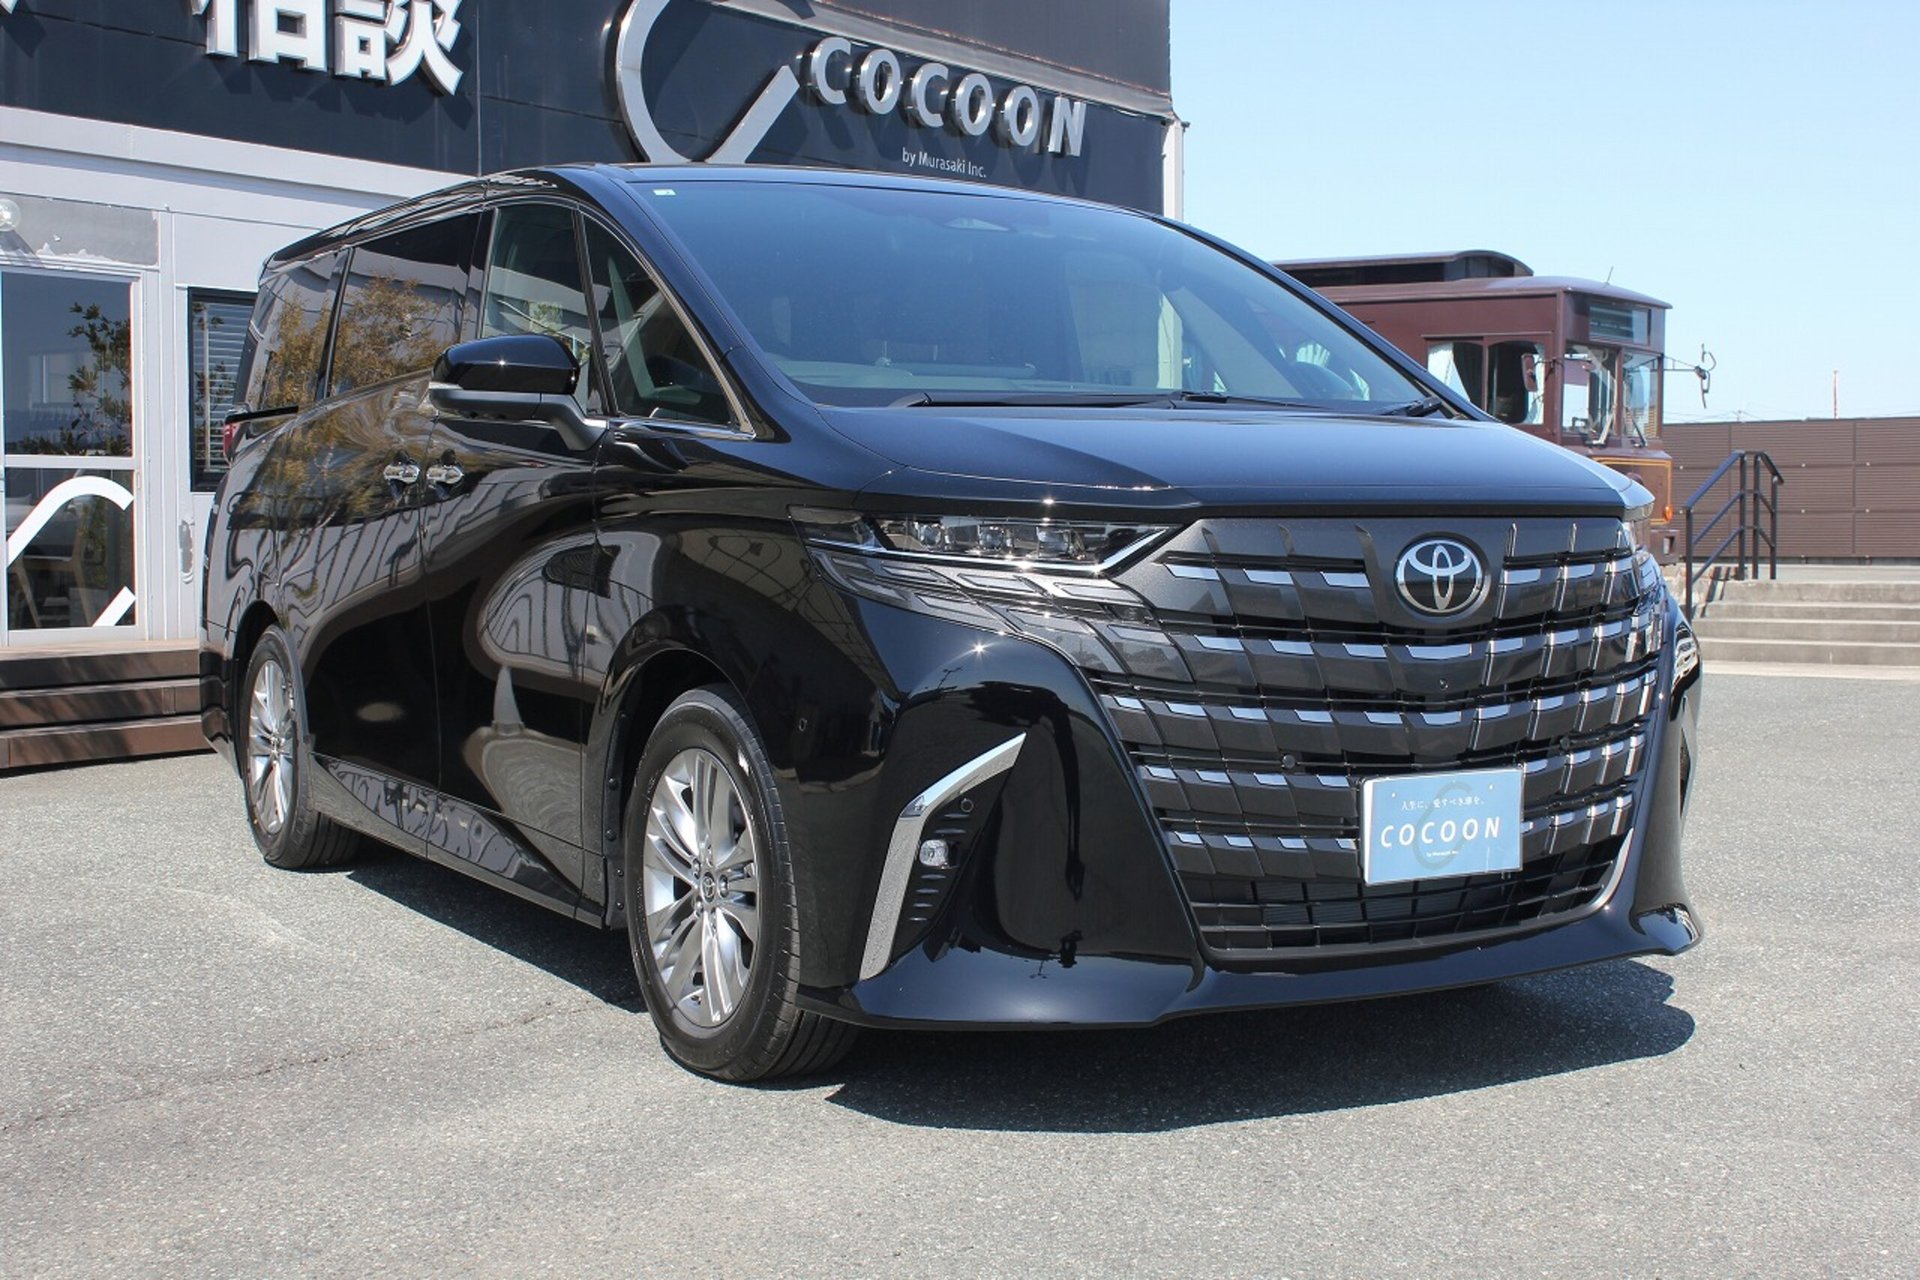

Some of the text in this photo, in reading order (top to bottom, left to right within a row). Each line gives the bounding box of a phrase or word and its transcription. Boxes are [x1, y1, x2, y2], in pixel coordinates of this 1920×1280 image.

[809, 36, 1087, 157] COCOON
[902, 147, 987, 178] by Murasaki Inc.
[1380, 816, 1500, 848] COCOON
